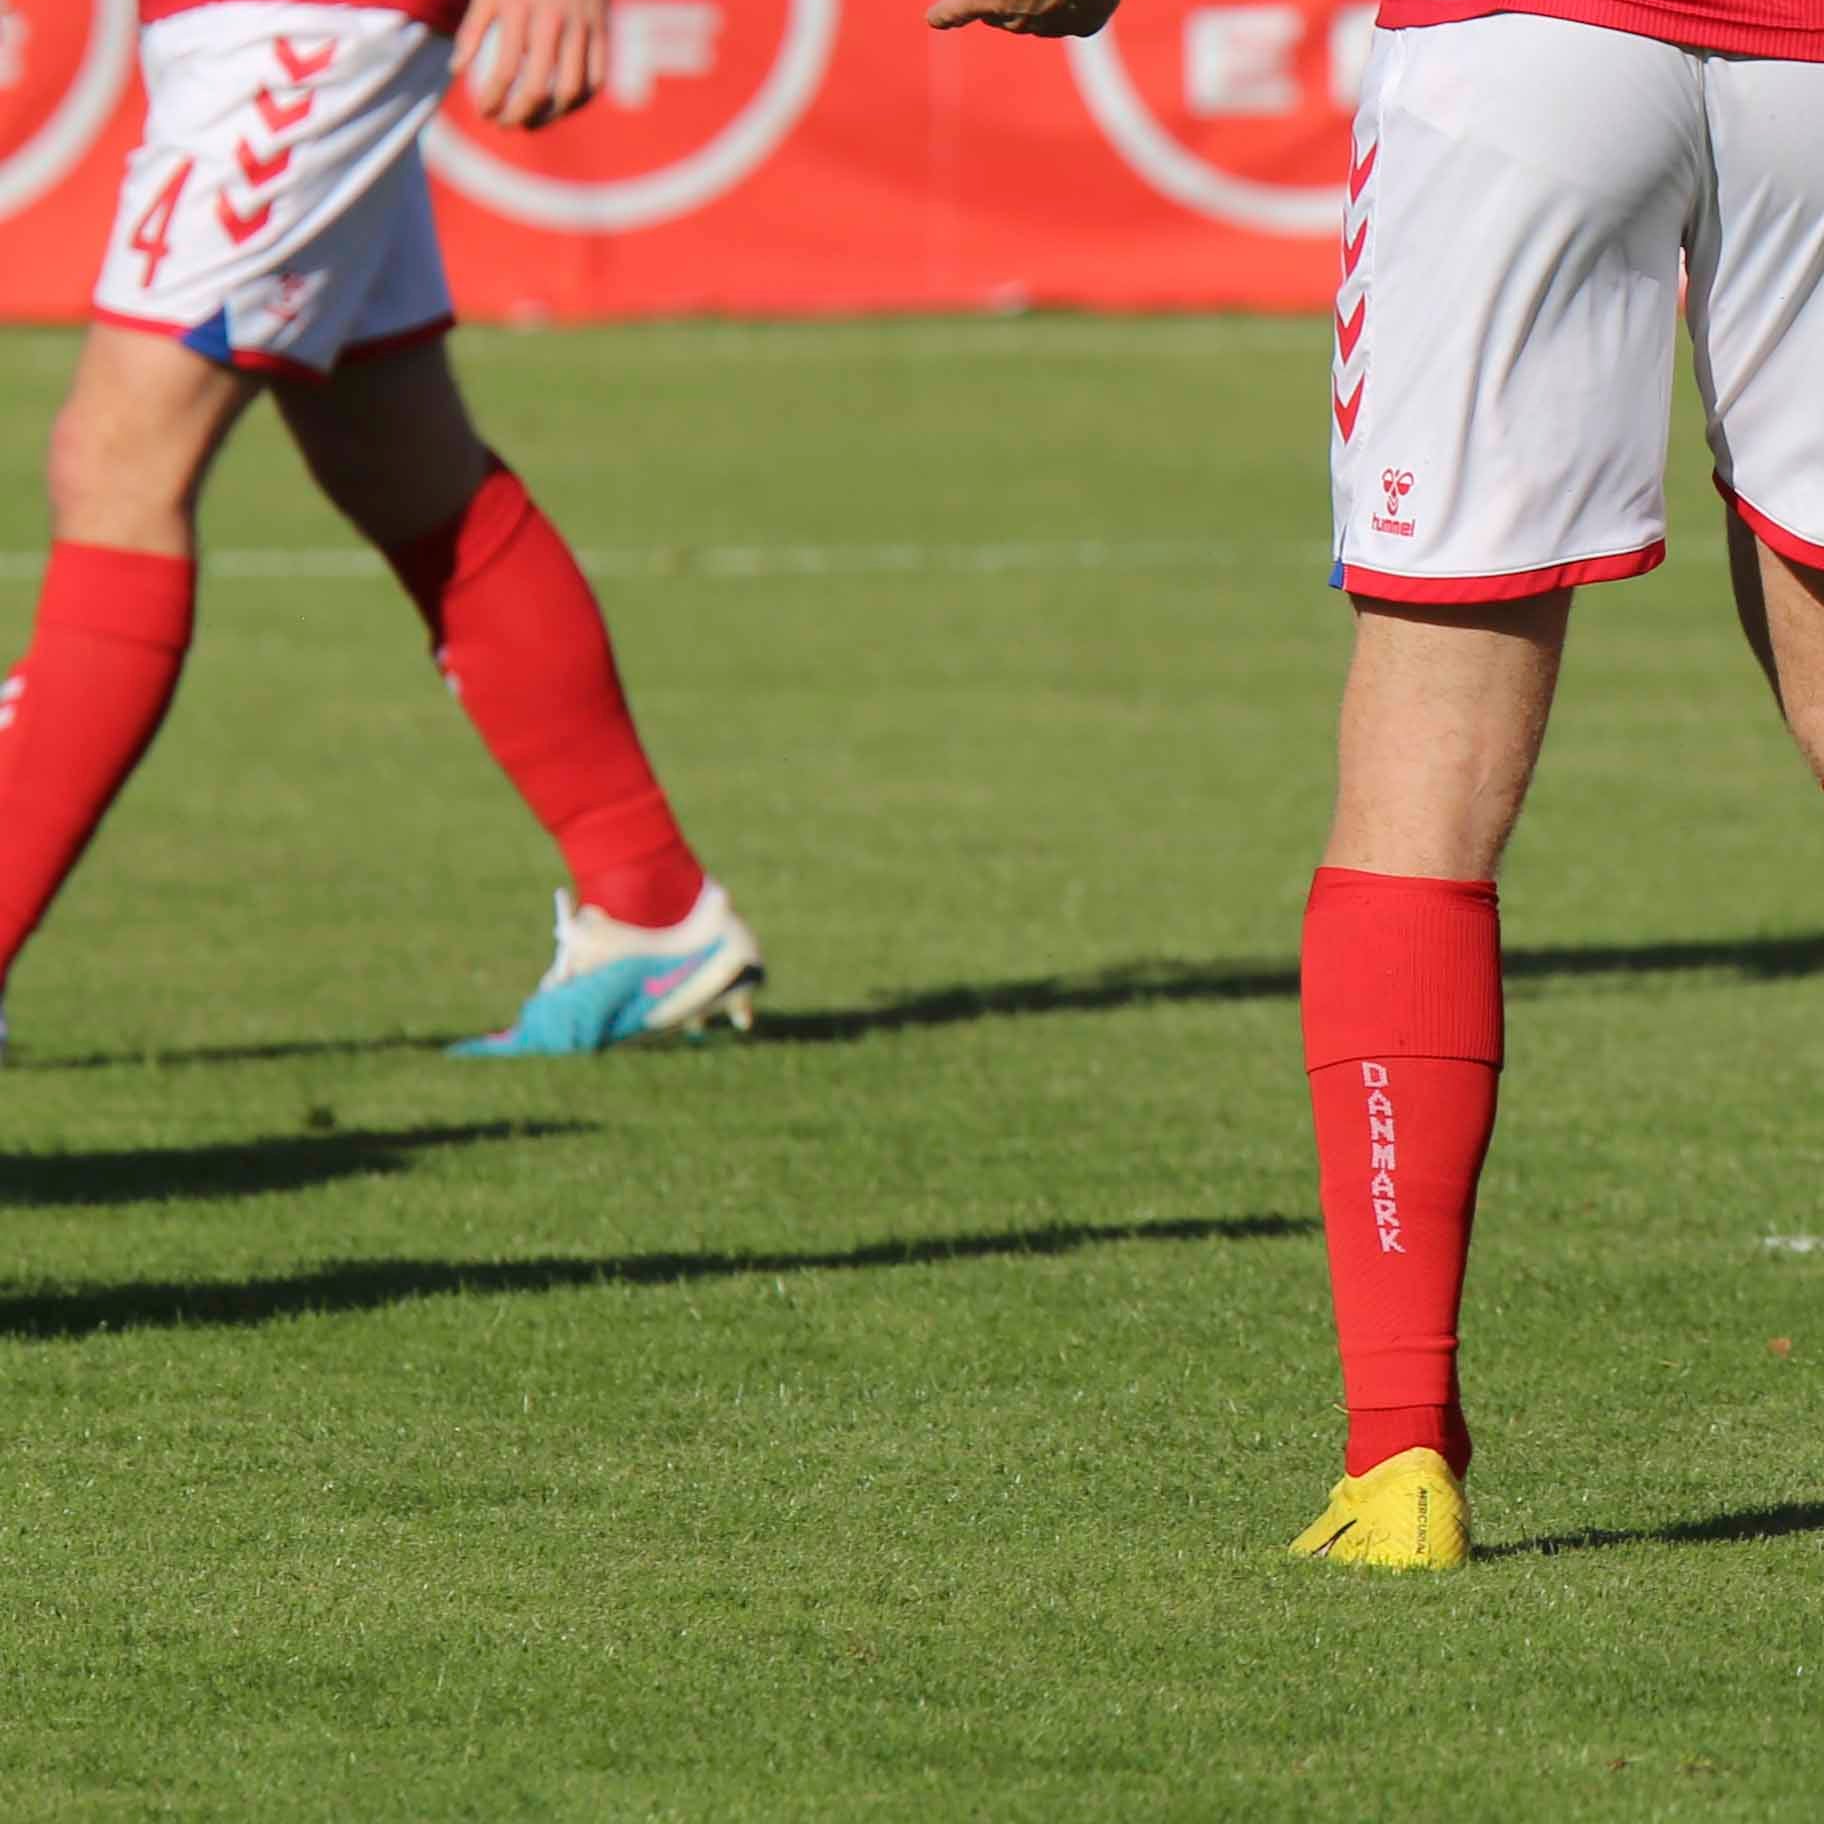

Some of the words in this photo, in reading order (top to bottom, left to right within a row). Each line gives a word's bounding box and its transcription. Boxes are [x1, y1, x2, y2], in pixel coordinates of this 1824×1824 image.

[129, 154, 197, 289] 4
[1371, 513, 1416, 538] hummel
[1361, 1061, 1406, 1254] DANMARK
